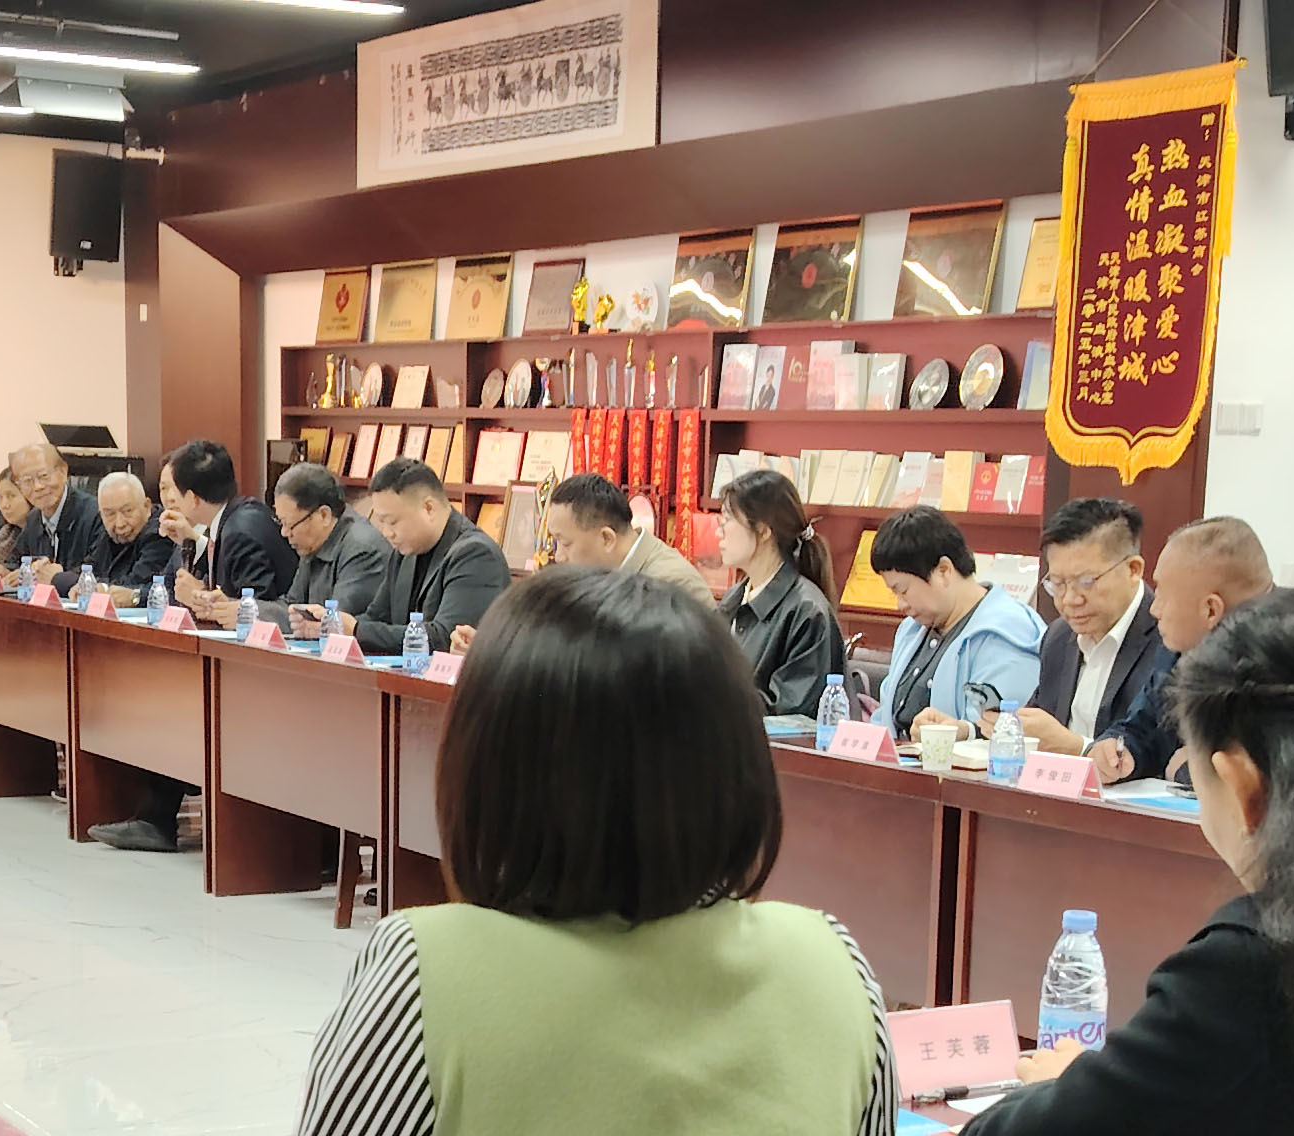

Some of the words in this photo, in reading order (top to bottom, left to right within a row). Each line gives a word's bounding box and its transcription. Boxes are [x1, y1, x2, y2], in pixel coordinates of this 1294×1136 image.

[1116, 141, 1156, 387] 真情温暖津城
[1150, 137, 1190, 375] 热血凝聚爱心
[917, 1033, 992, 1062] 王芙蓉
